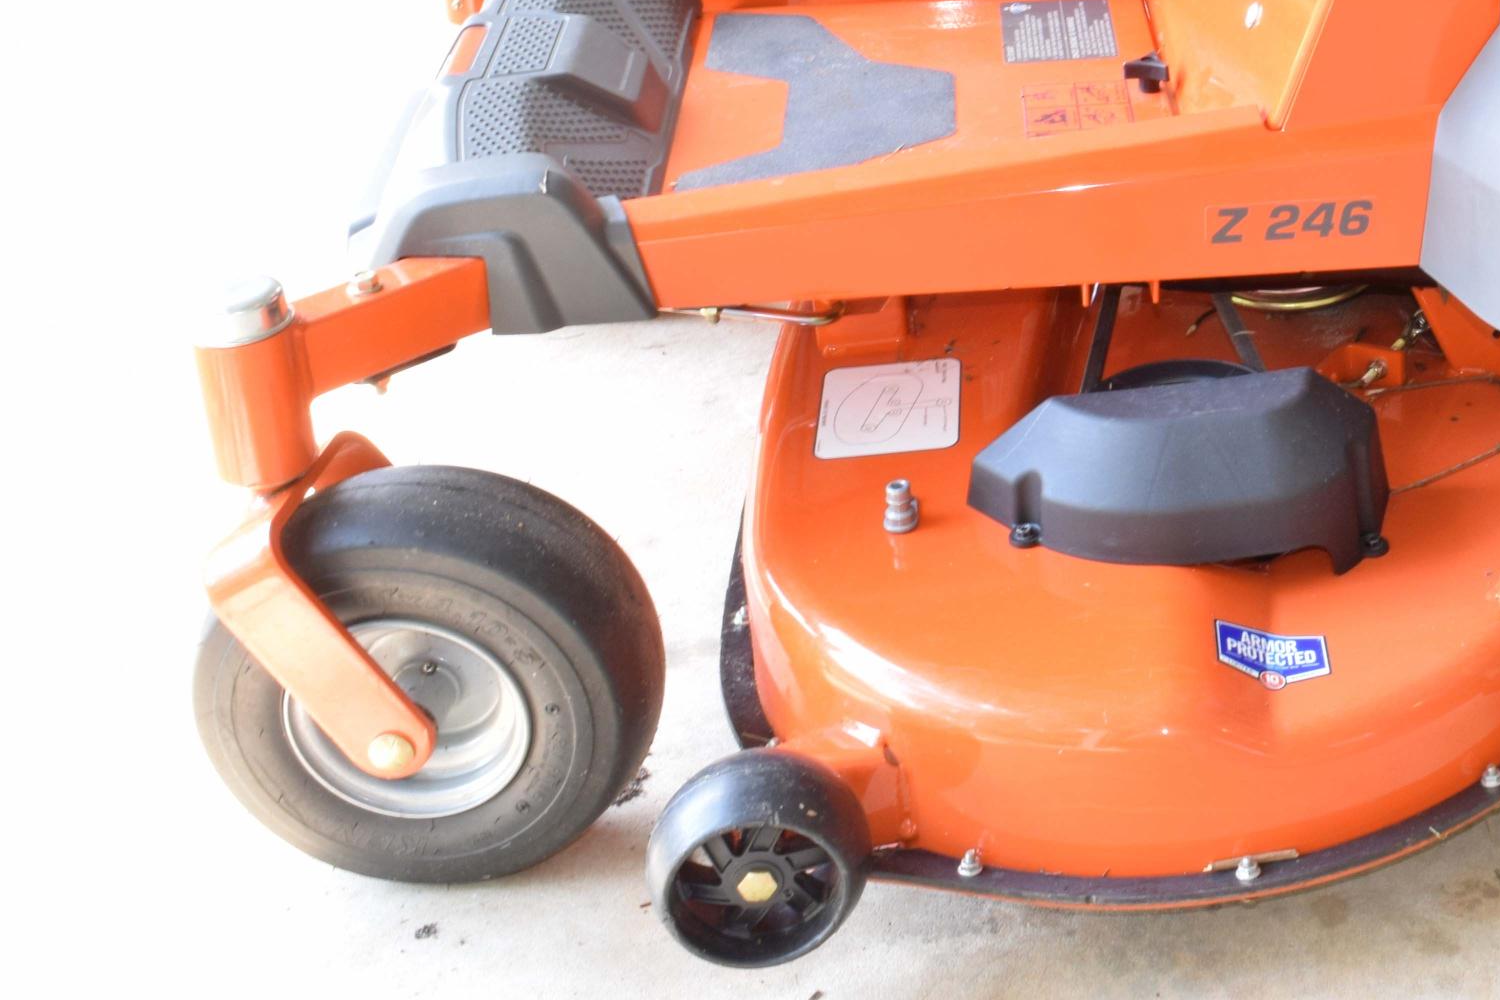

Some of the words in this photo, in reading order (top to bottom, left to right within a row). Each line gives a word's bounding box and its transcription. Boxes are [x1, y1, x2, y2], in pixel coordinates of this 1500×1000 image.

[1211, 206, 1249, 244] Z
[1264, 200, 1373, 241] 246
[1226, 636, 1318, 667] PROTECTED
[1241, 630, 1298, 654] ARMOR
